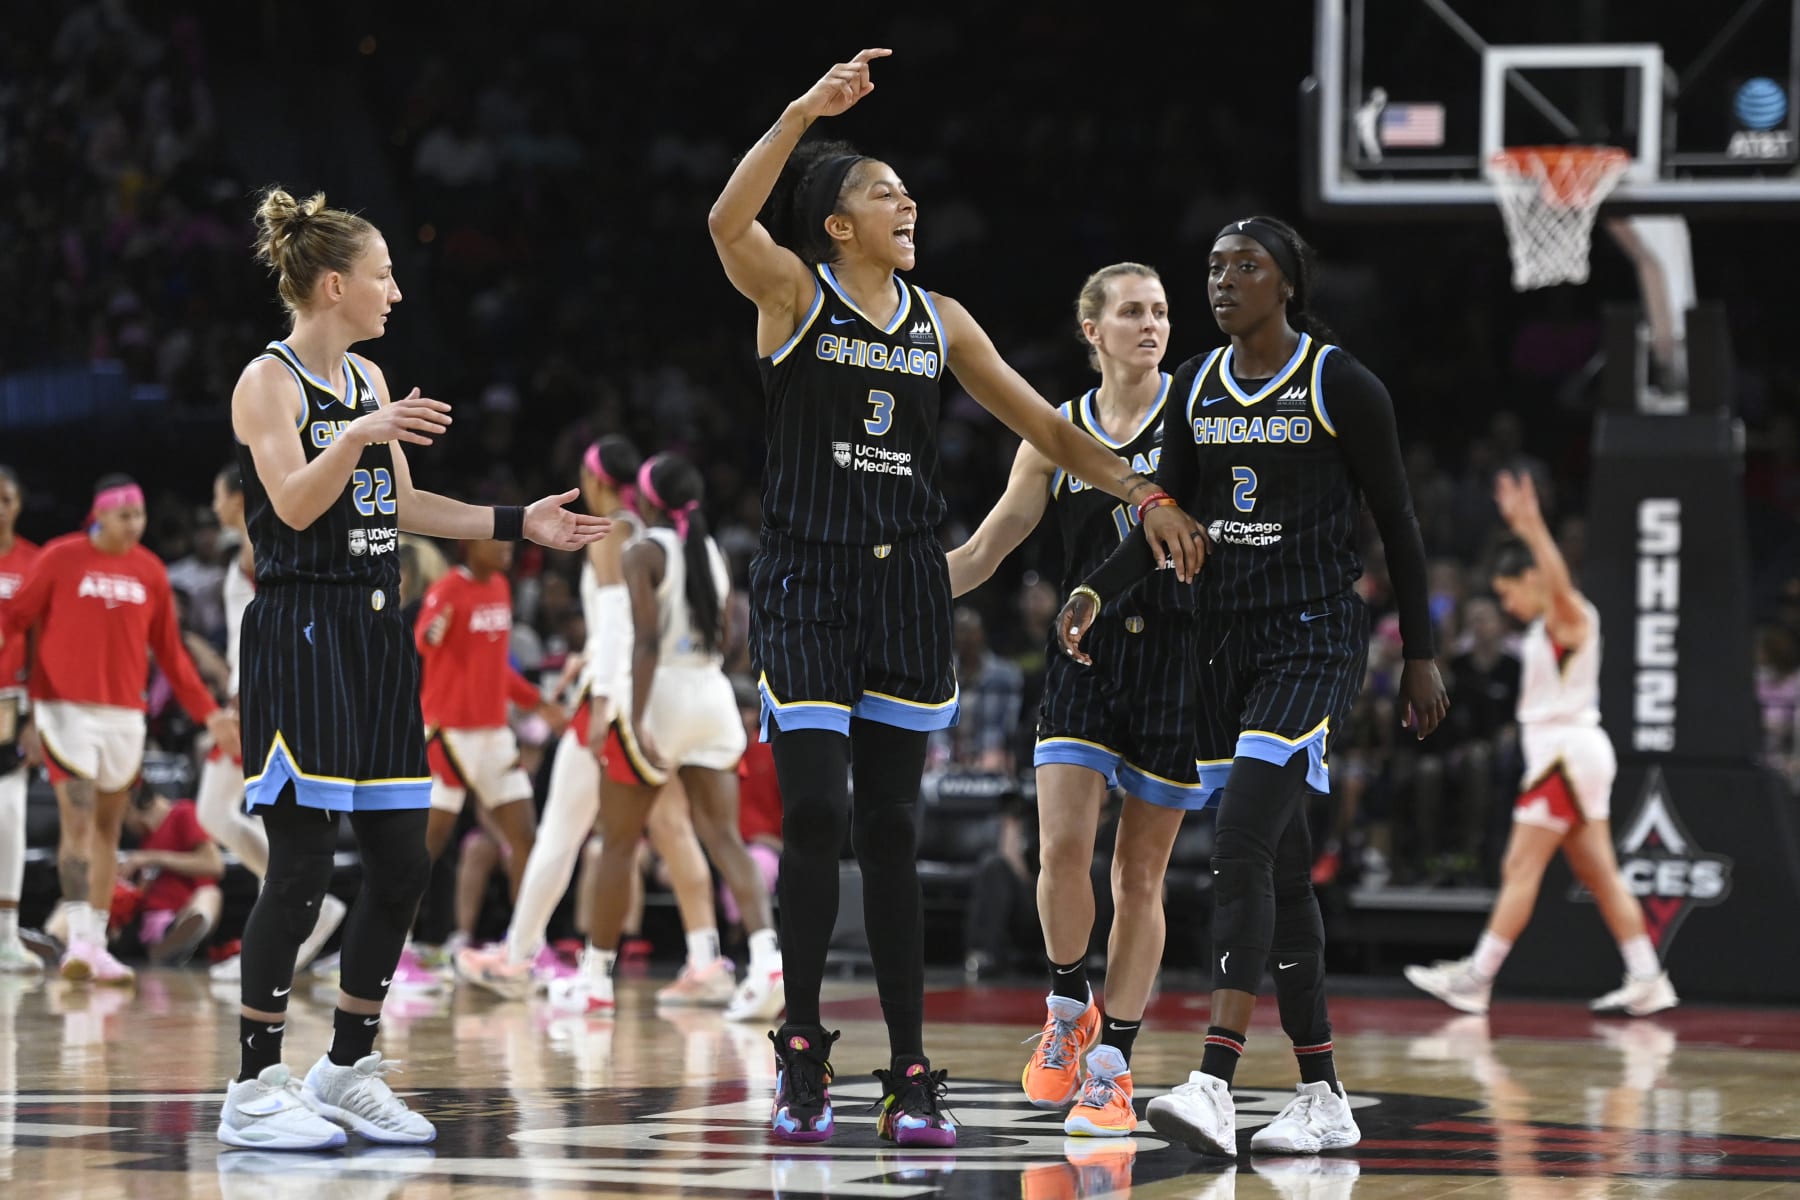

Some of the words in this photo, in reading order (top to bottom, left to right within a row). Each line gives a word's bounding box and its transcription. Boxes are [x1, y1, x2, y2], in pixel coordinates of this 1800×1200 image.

[1726, 130, 1791, 160] AT&T
[816, 333, 938, 379] CHICAGO
[863, 389, 895, 436] 3
[1193, 416, 1313, 444] CHICAGO
[853, 458, 913, 477] Medicine
[855, 444, 912, 463] UChicago
[352, 468, 397, 516] 22
[1231, 466, 1258, 512] 2
[1223, 534, 1283, 547] Medicine
[1224, 520, 1283, 535] UChicago
